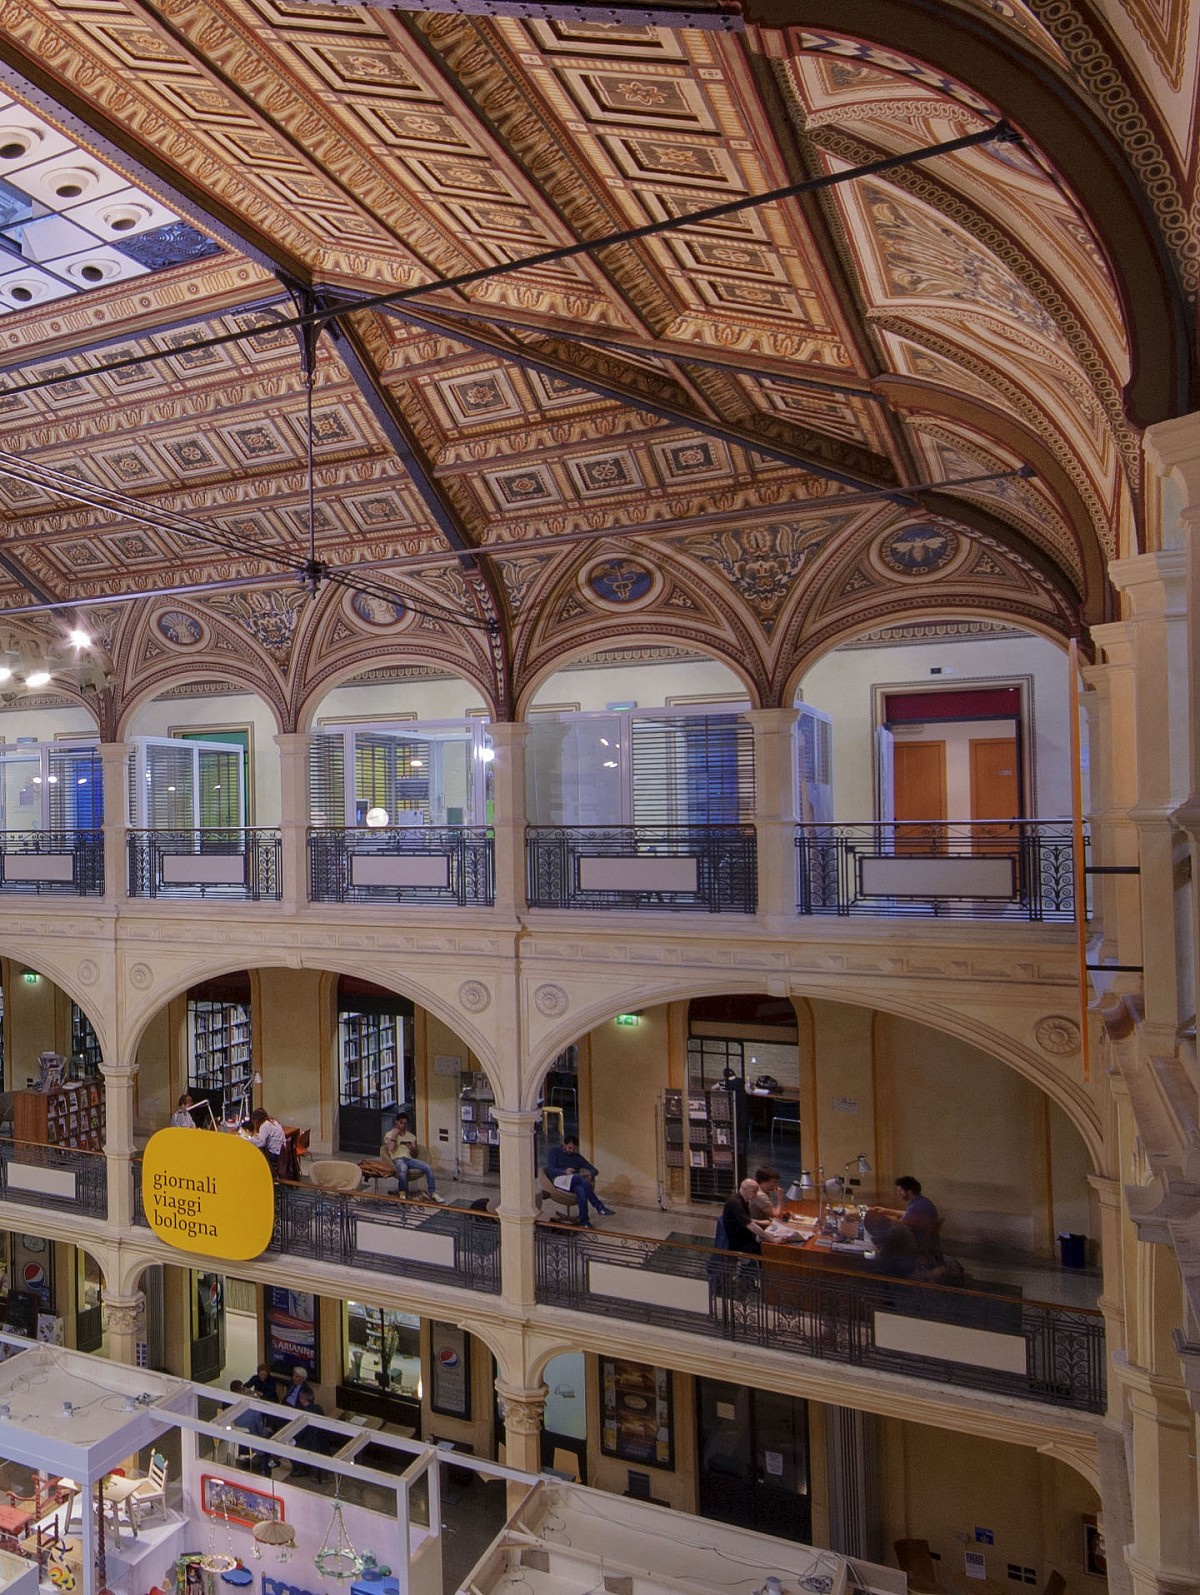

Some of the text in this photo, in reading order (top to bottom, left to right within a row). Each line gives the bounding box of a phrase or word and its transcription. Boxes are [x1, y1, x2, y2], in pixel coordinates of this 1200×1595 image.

[911, 566, 929, 574] ED
[153, 1170, 217, 1195] giornali
[153, 1190, 202, 1217] viaggi
[154, 1209, 218, 1238] bologna
